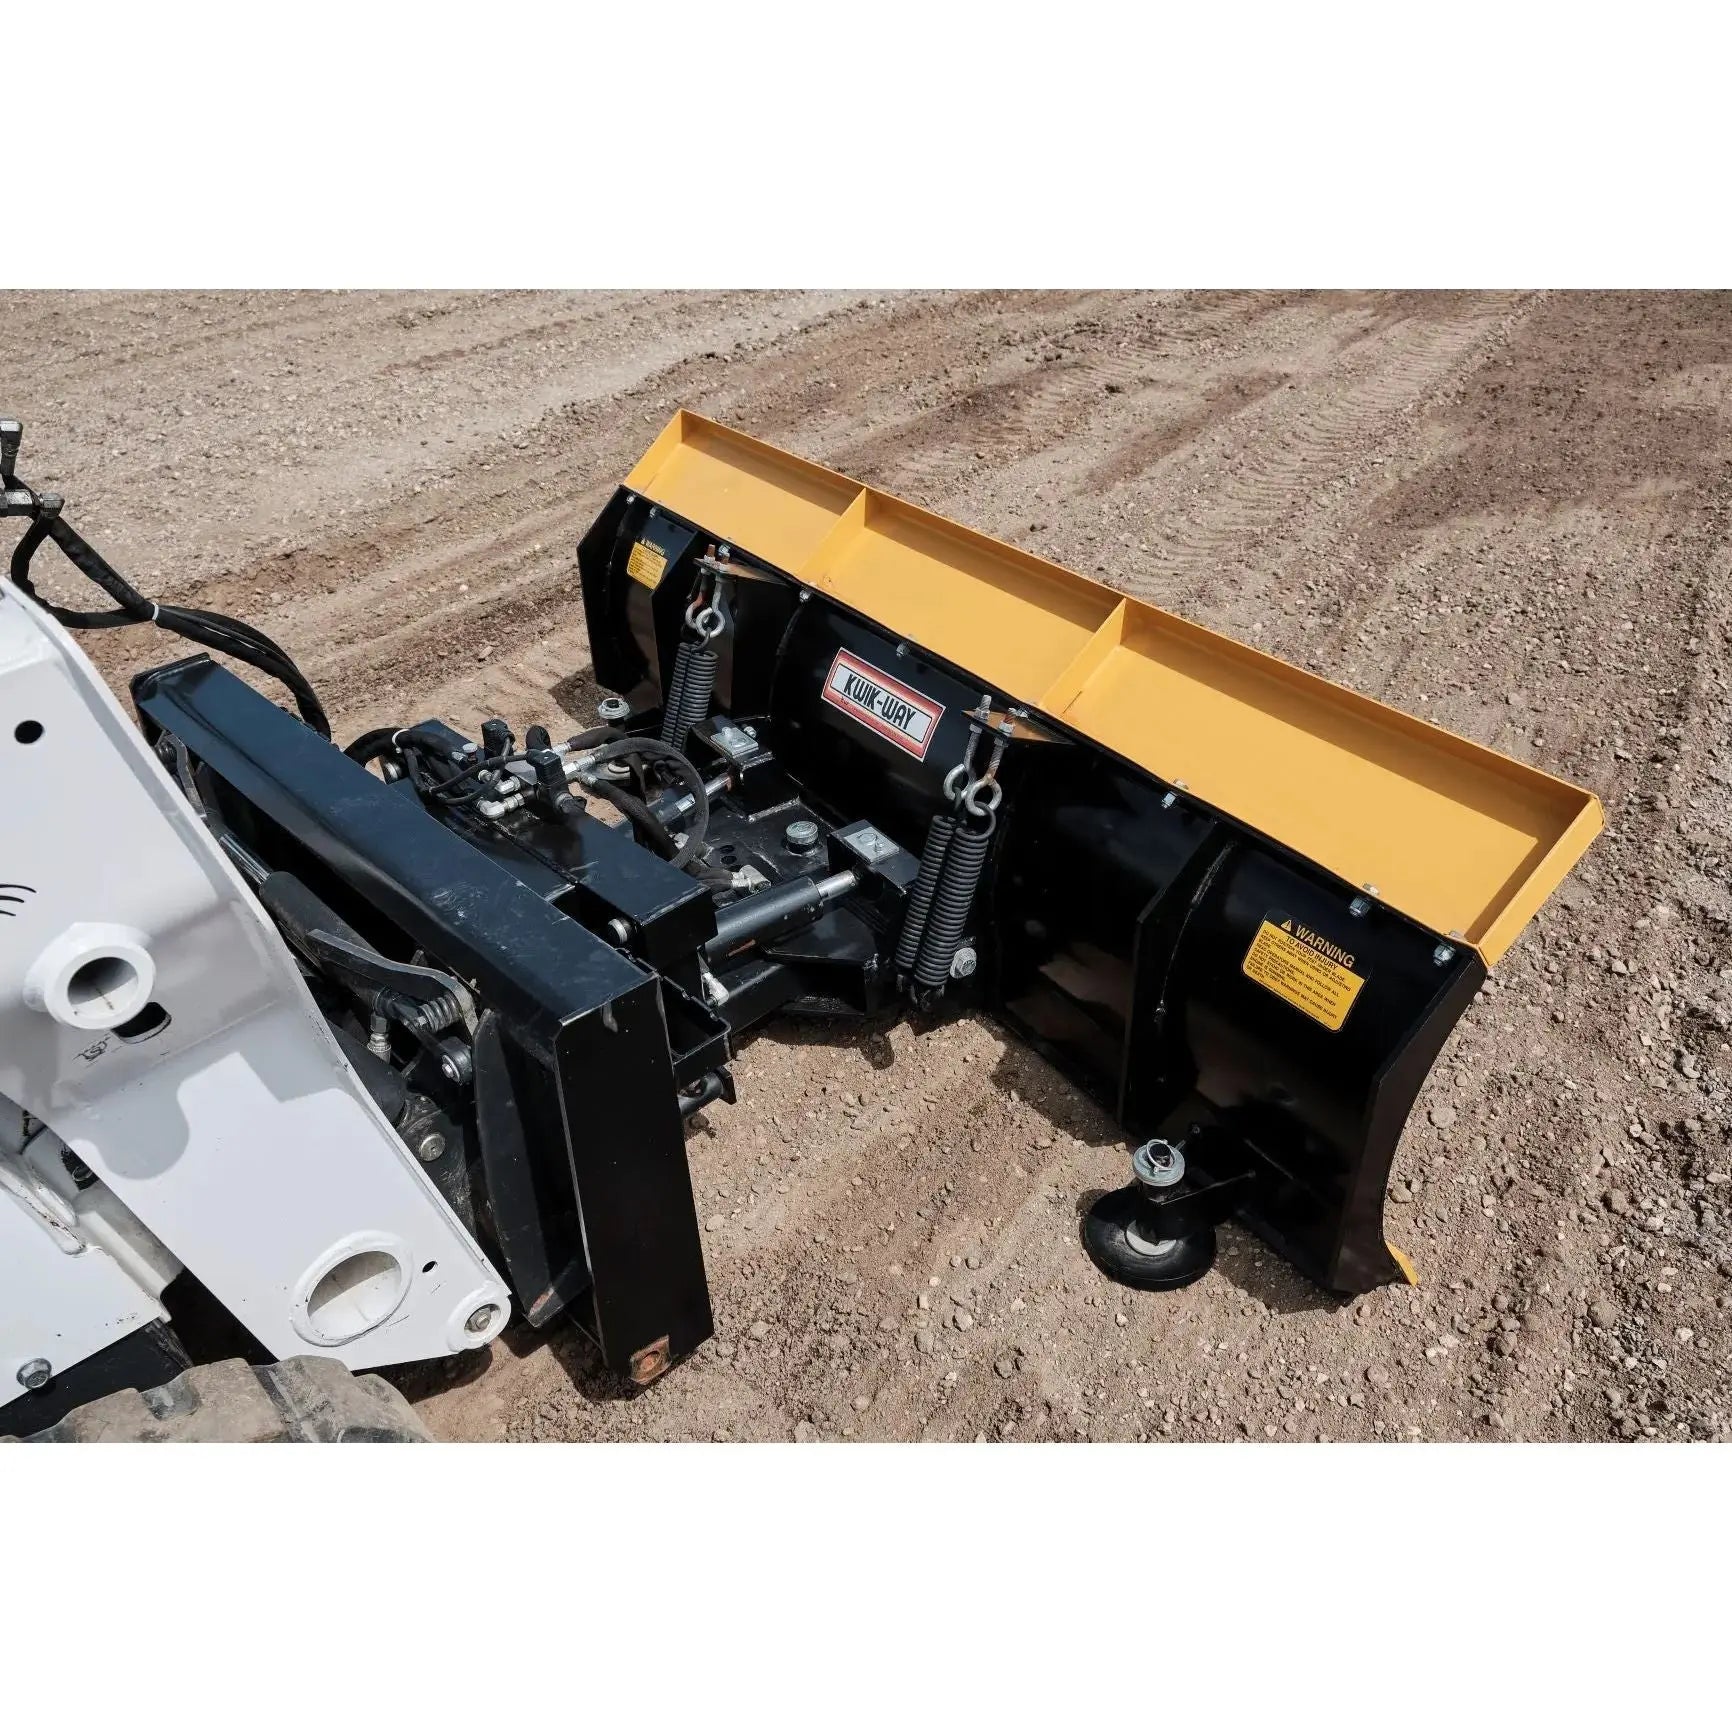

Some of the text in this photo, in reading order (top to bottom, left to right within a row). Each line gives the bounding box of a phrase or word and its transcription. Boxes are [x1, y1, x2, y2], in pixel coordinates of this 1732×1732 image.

[844, 673, 917, 730] KWIK-WAY
[1285, 936, 1338, 971] TO AVOID INJURY
[1296, 924, 1355, 968] WARNING
